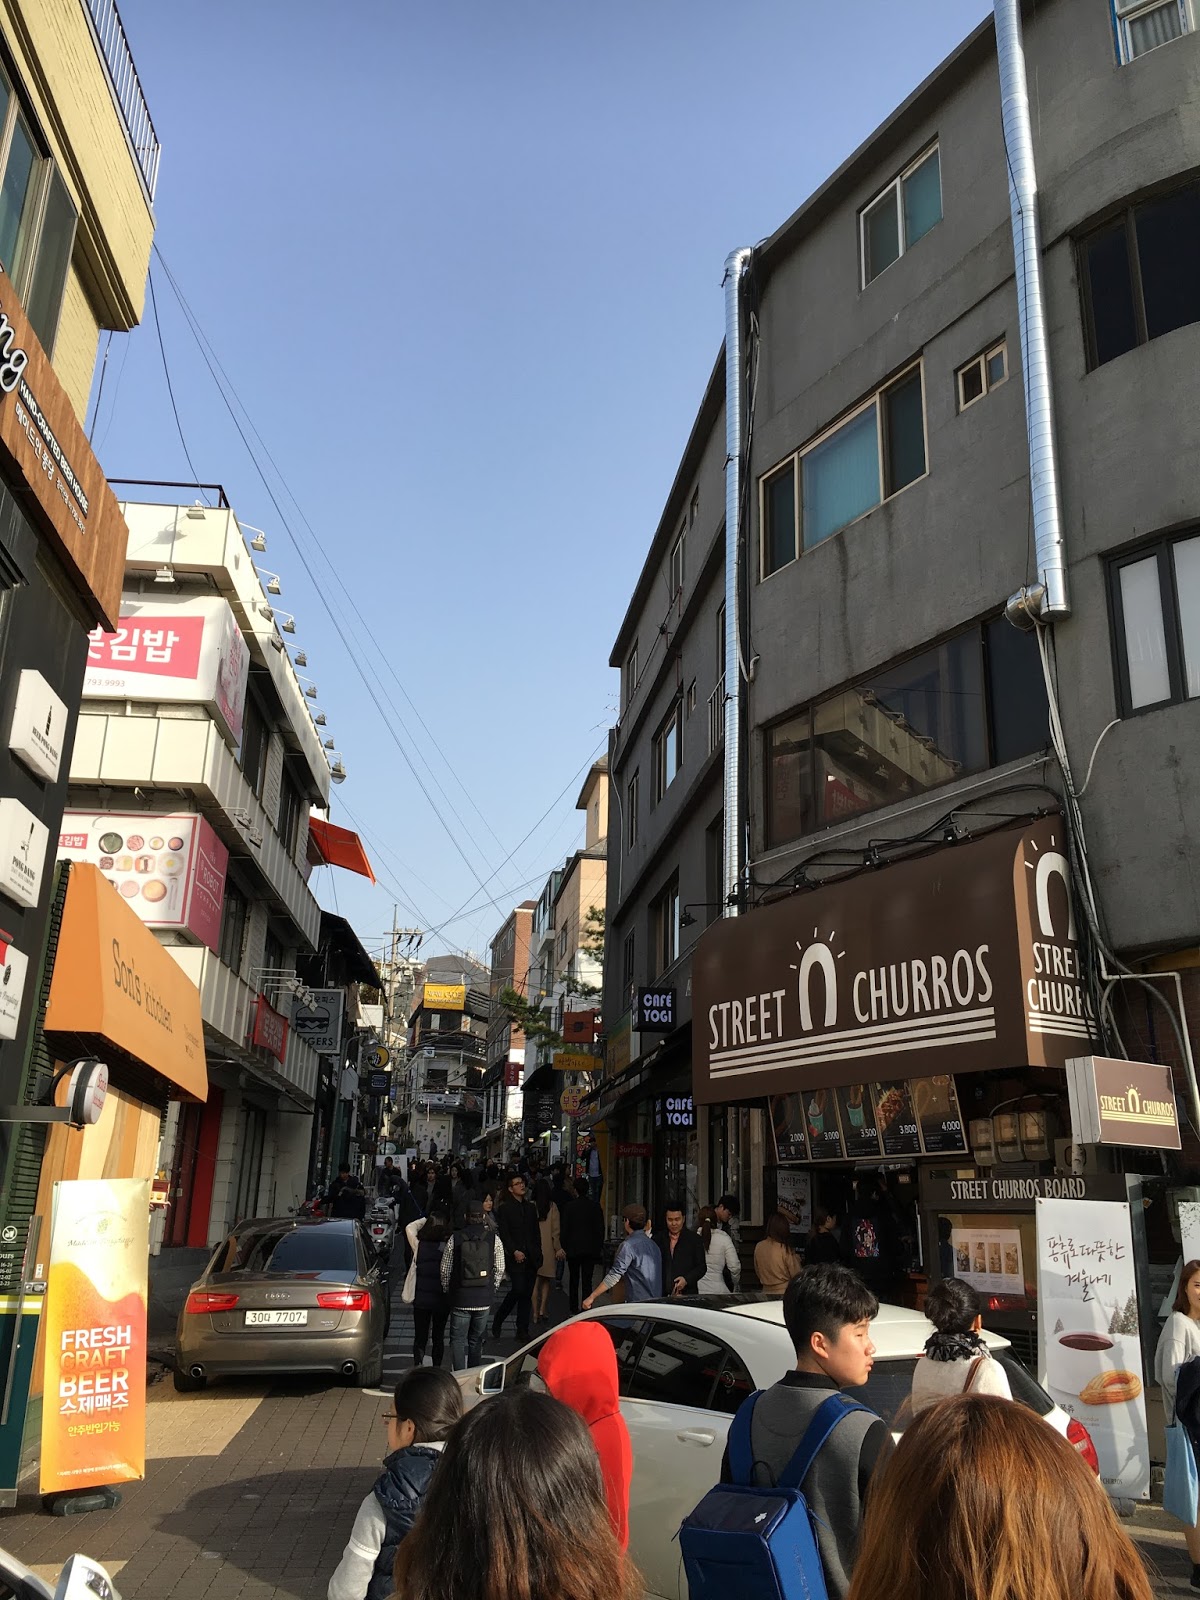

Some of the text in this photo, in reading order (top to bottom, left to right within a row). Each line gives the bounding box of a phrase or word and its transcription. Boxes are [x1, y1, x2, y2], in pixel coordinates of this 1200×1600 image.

[20, 379, 61, 461] HAND-CRAFTED
[203, 867, 219, 894] ROBOT
[643, 991, 672, 1008] CAFÉ
[709, 989, 786, 1050] STREET
[852, 944, 993, 1024] CHURROS
[643, 1009, 672, 1023] YOGI
[665, 1096, 693, 1111] CAFÉ
[1100, 1095, 1175, 1117] STREET CHURROS
[666, 1112, 693, 1126] YOGI
[950, 1177, 1086, 1200] STREET CHURROS BOARD
[1065, 1268, 1112, 1302] 겨울나기
[276, 1312, 302, 1323] 7707
[61, 1325, 131, 1351] FRESH
[60, 1346, 131, 1370] CRAFT
[59, 1367, 130, 1398] BEER
[59, 1392, 129, 1416] 수제맥주
